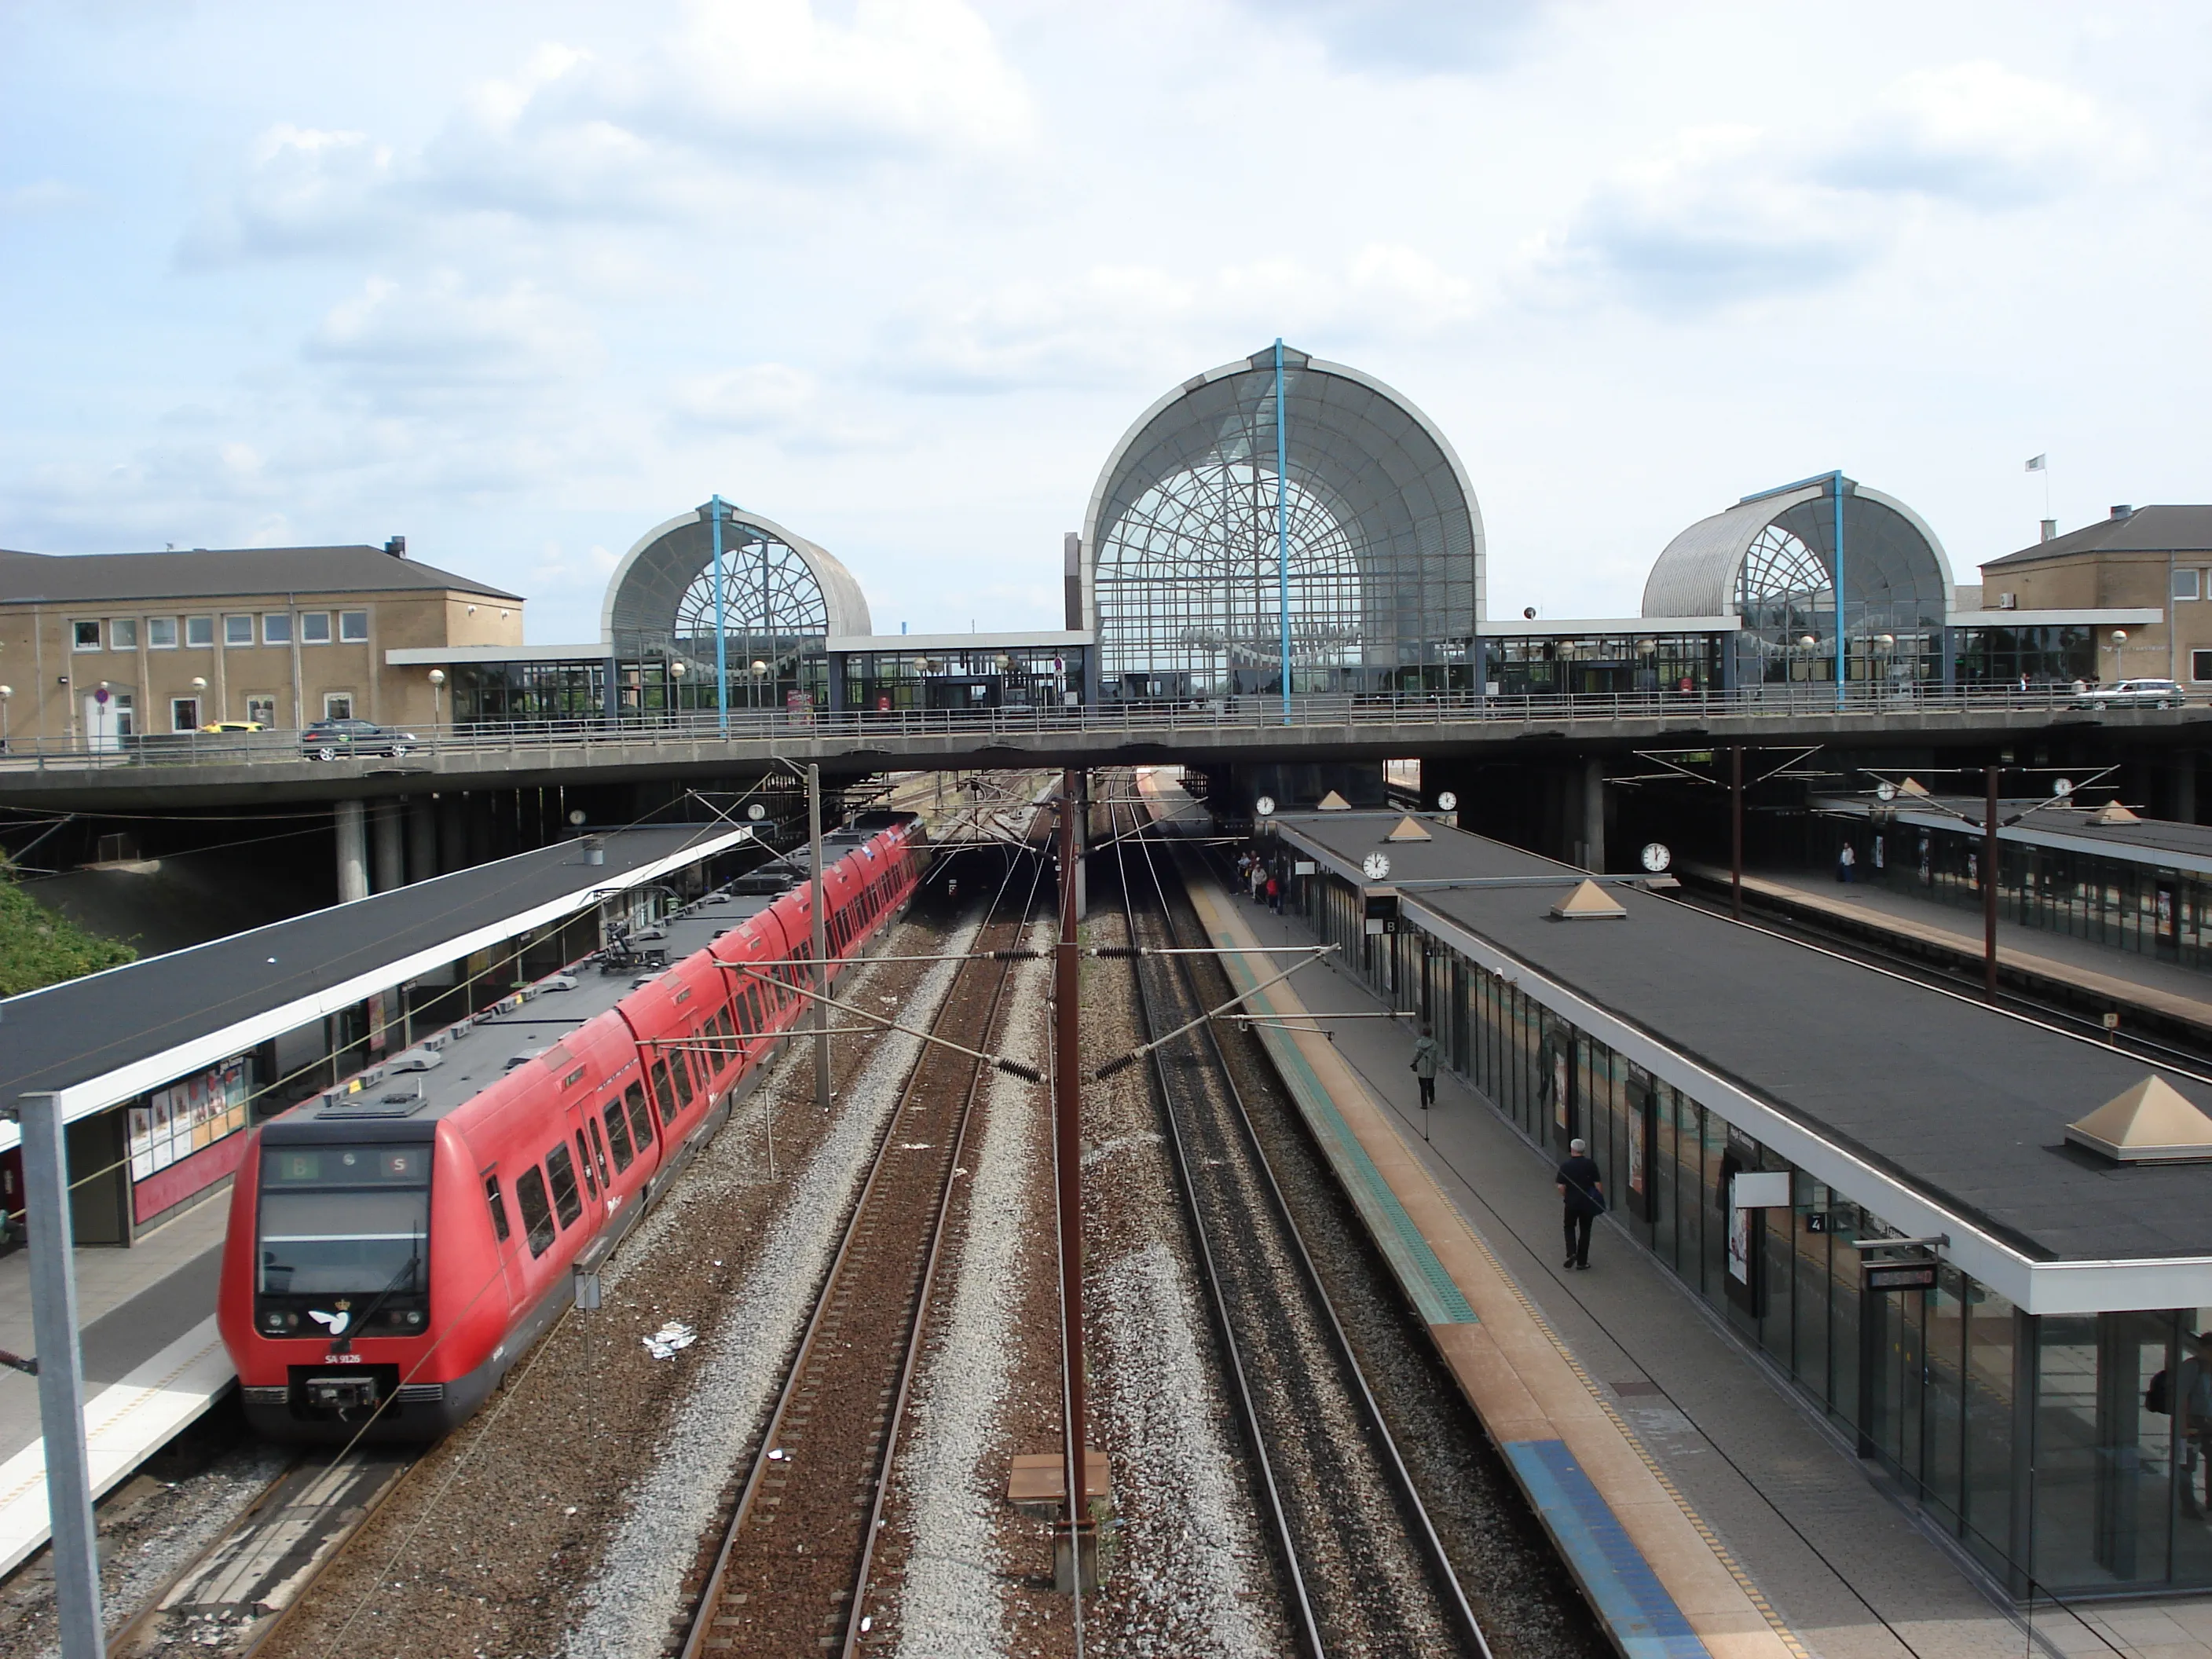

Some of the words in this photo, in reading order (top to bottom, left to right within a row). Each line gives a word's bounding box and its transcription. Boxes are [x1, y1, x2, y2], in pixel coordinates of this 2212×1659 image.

[1387, 921, 1395, 932] B
[293, 1158, 306, 1176] B
[1812, 1219, 1821, 1230] 4
[324, 1354, 338, 1364] SA
[339, 1354, 361, 1364] 9126
